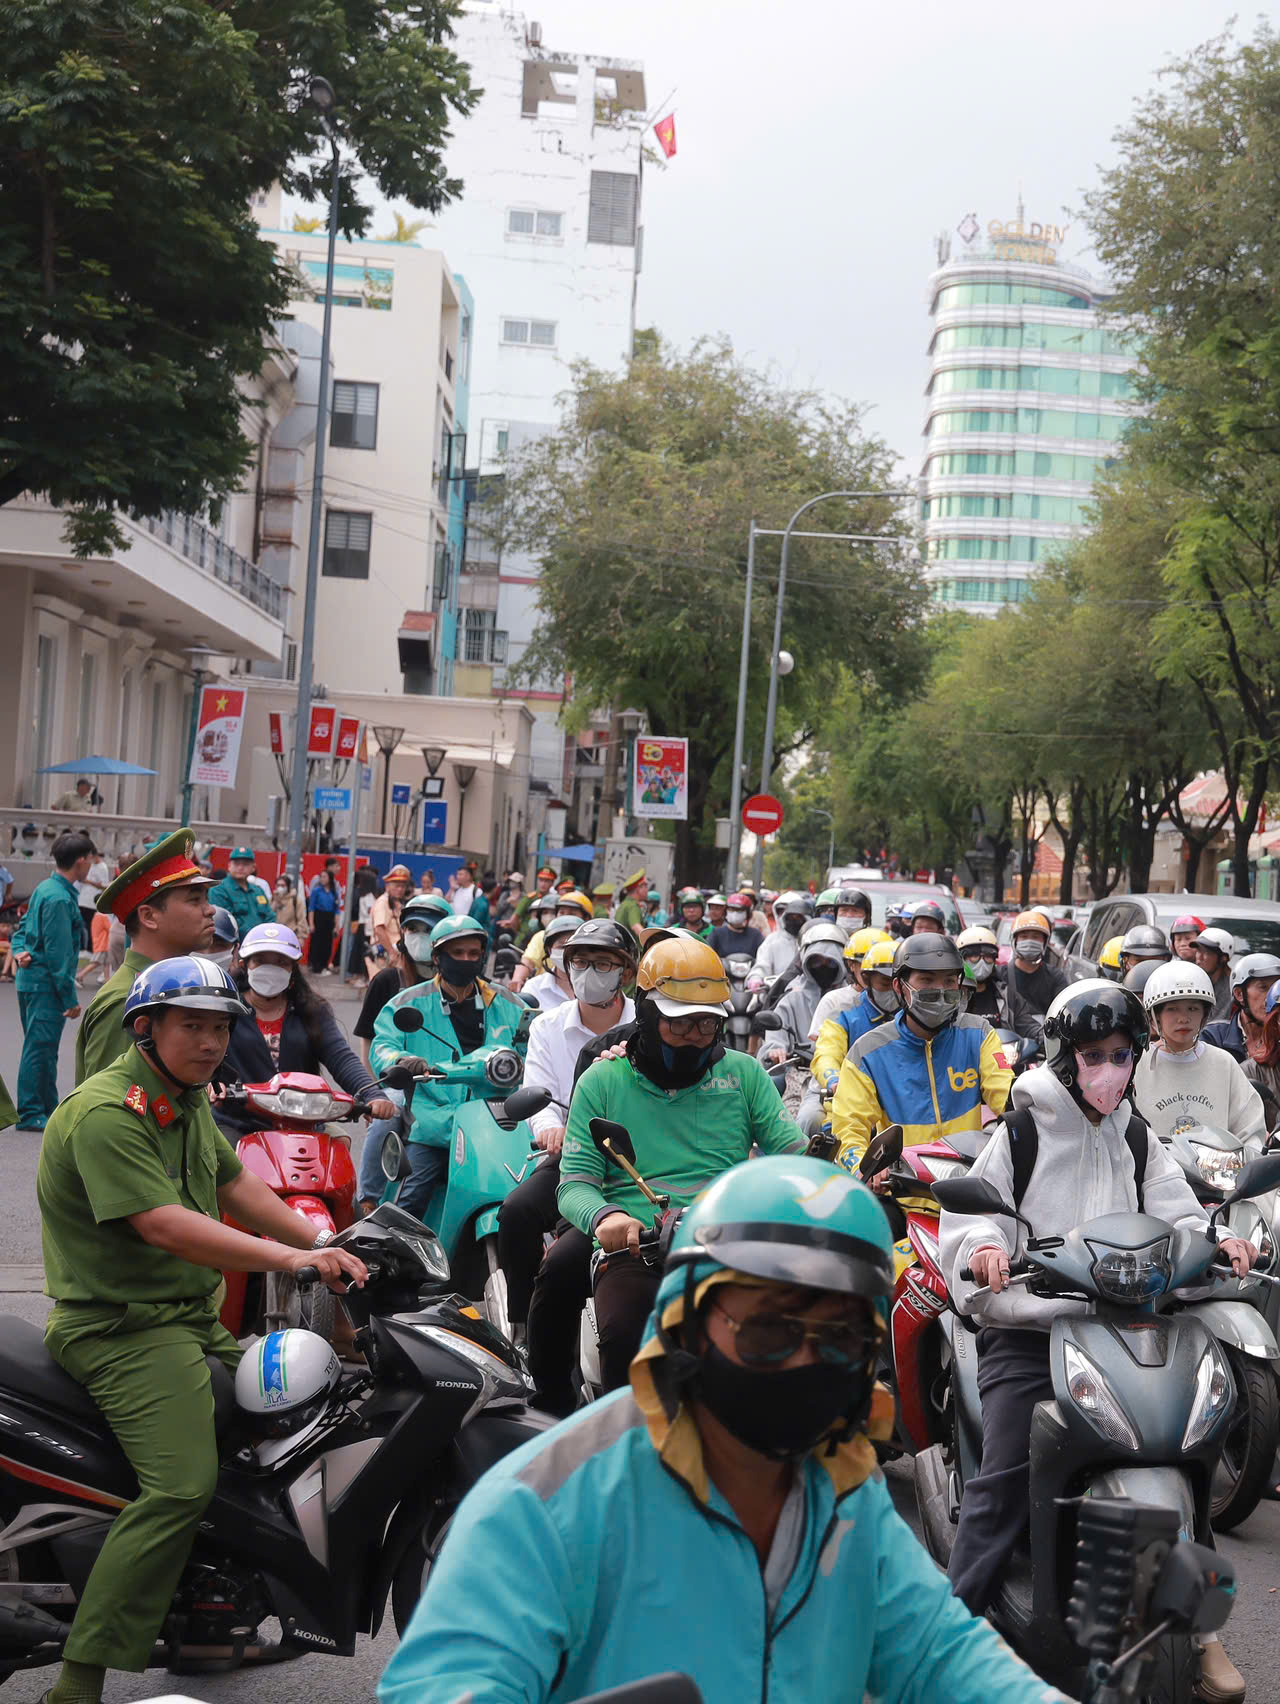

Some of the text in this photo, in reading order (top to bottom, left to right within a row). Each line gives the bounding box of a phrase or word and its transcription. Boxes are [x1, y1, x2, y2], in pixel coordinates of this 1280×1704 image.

[988, 219, 1064, 244] GOLDEN
[947, 1066, 978, 1092] be
[1155, 1092, 1214, 1111] Black coffee
[904, 1290, 930, 1314] RSX
[435, 1380, 478, 1390] HONDA
[293, 1628, 336, 1647] HONDA
